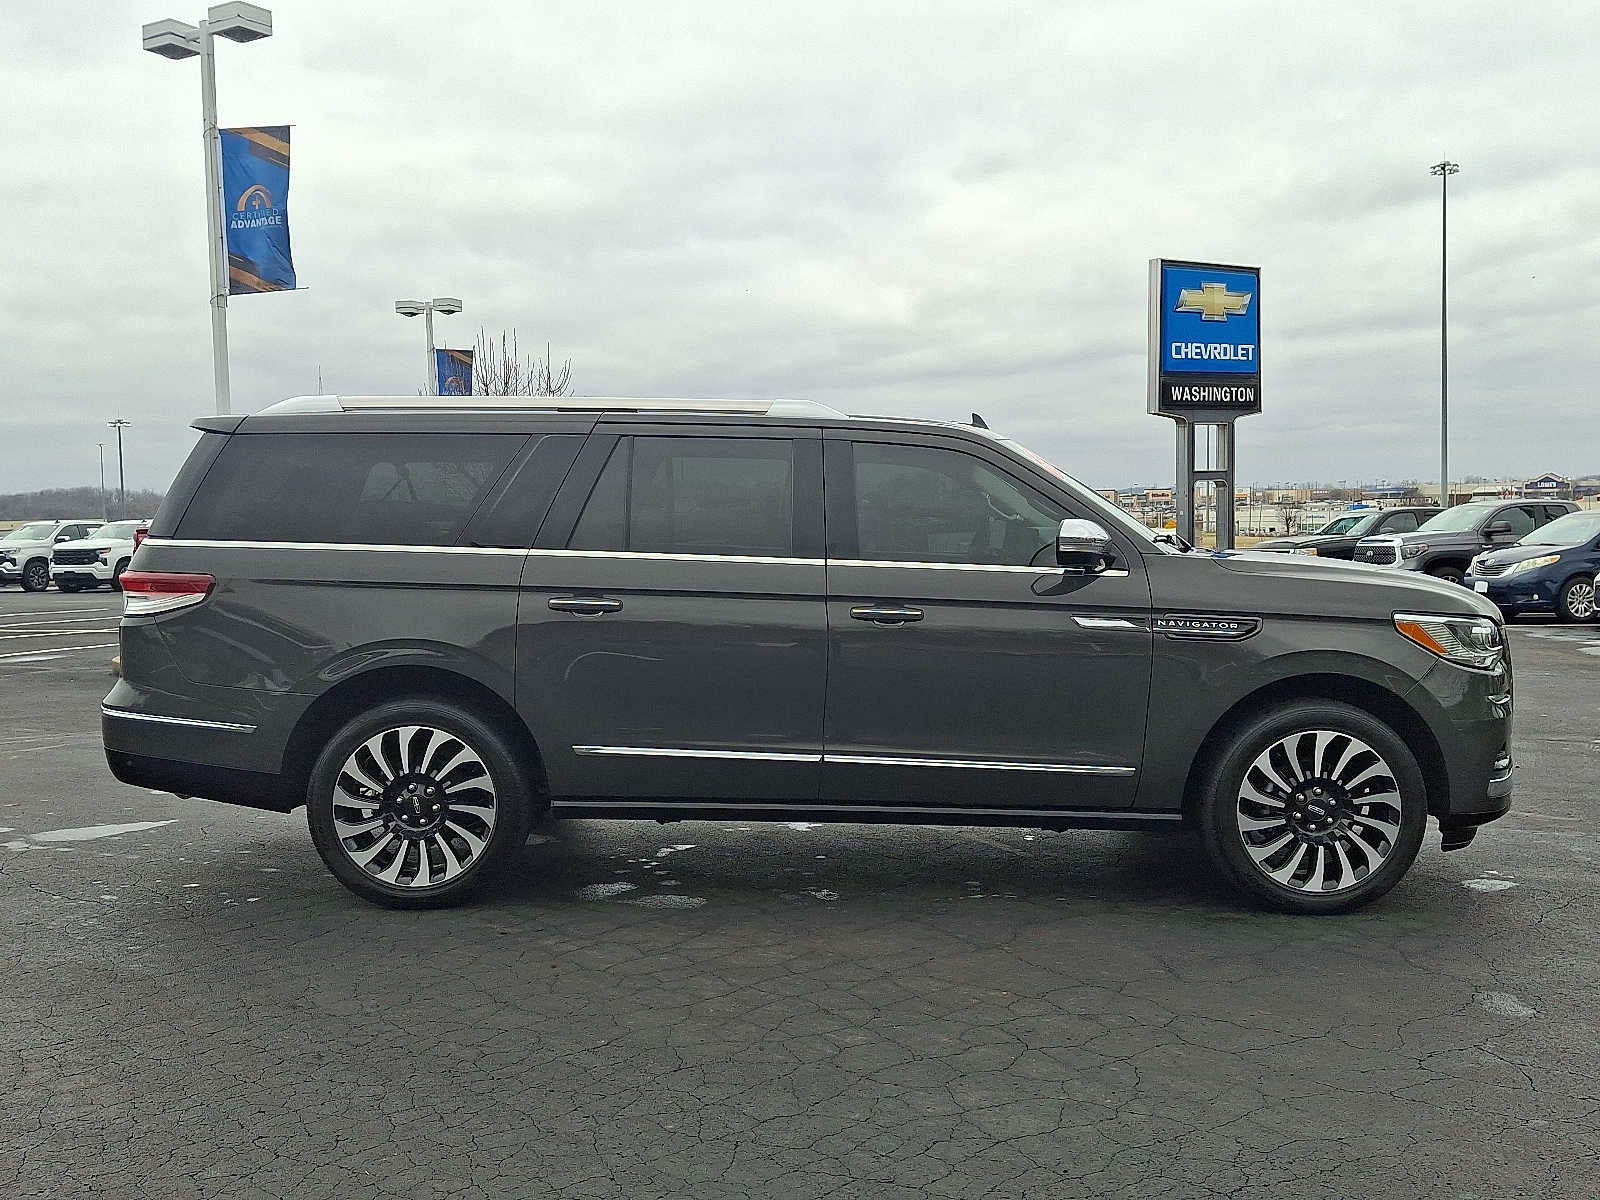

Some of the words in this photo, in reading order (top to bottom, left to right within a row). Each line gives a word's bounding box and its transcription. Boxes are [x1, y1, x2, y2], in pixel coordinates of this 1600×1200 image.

[231, 216, 282, 229] ADVANTAGE
[1171, 342, 1255, 361] CHEVROLET
[1171, 386, 1255, 402] WASHINGTON
[1157, 619, 1238, 629] NAVIGATOR
